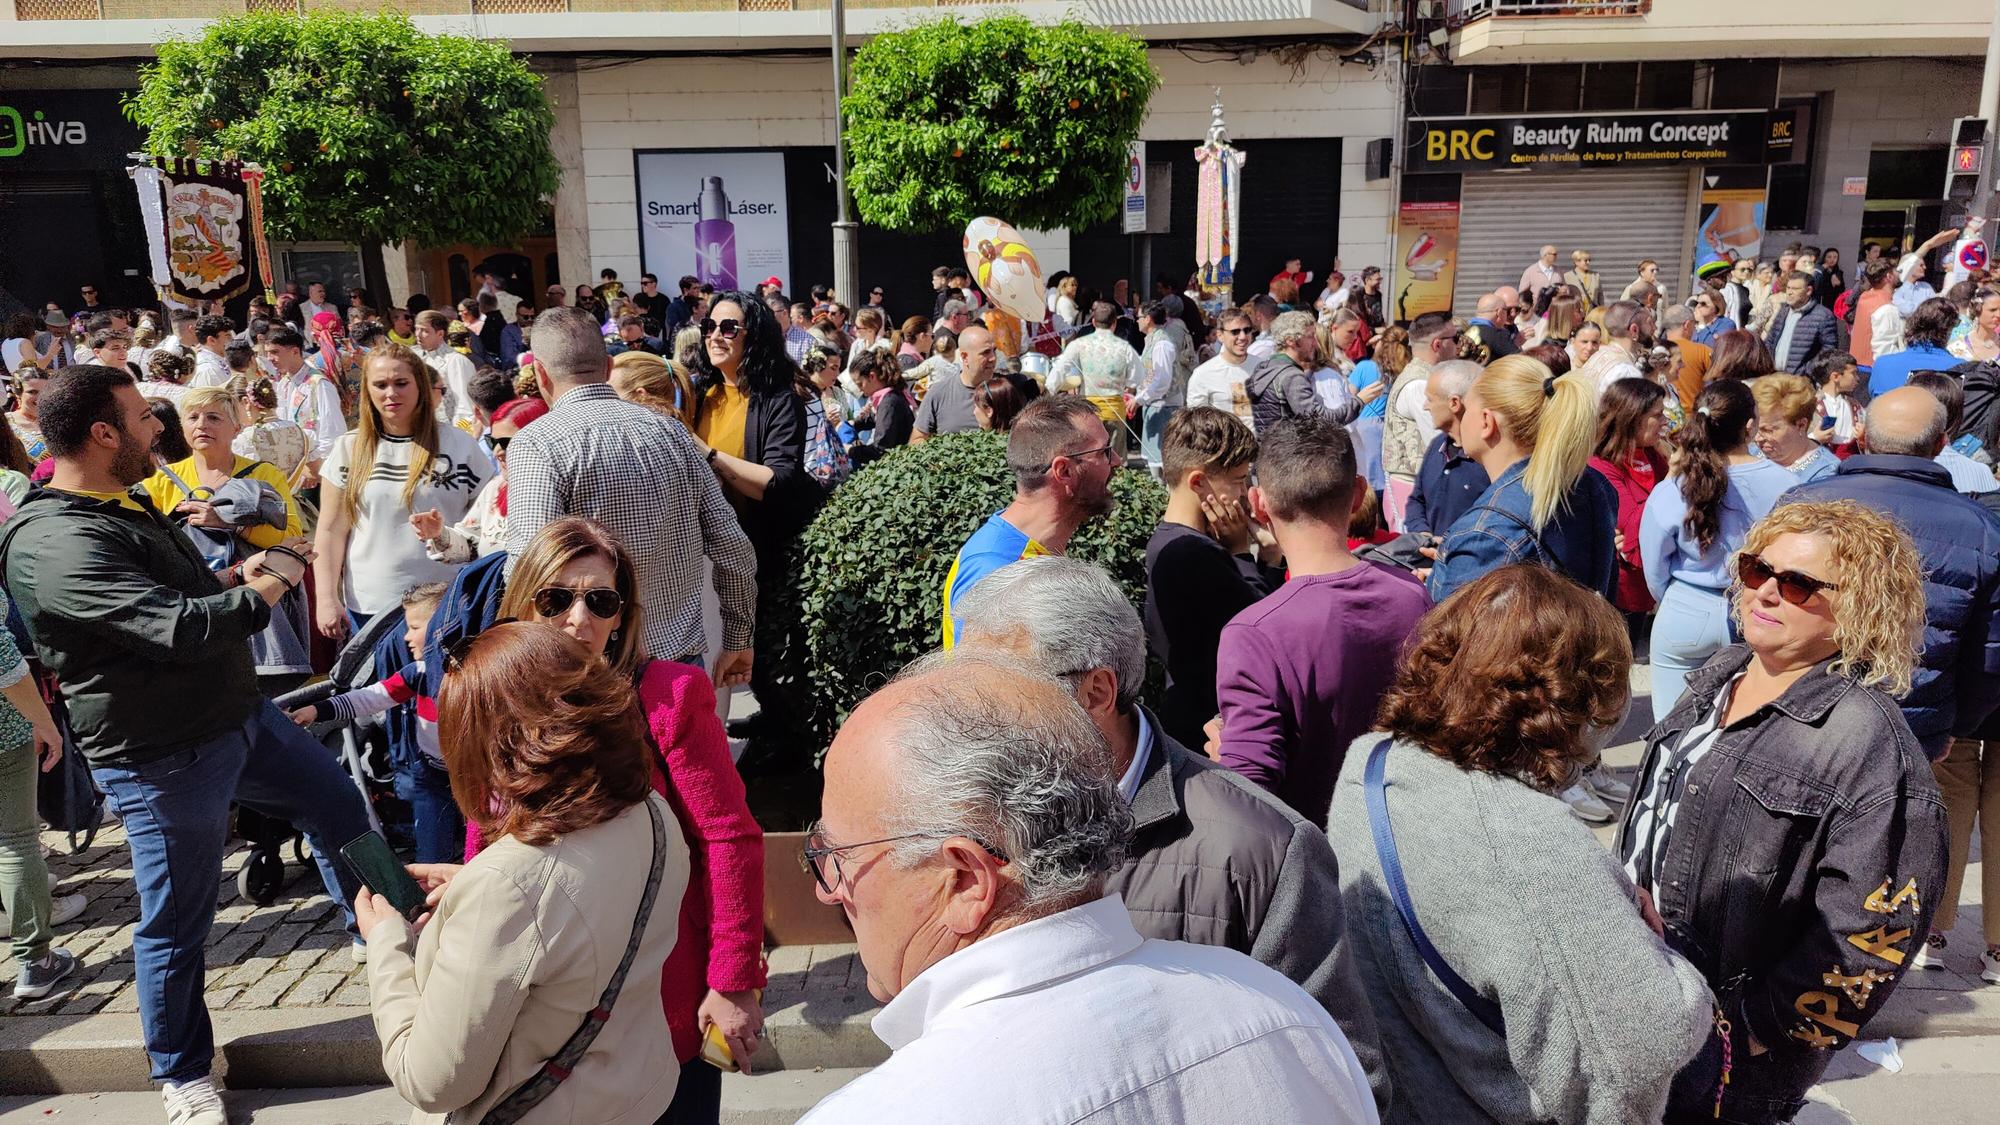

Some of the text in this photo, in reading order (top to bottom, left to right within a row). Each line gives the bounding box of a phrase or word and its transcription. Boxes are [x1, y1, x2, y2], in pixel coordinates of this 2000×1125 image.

[1512, 121, 1729, 150] Beauty Ruhm Concept
[1772, 121, 1791, 137] BRC
[1426, 129, 1495, 161] BRC
[1511, 149, 1728, 163] Centro de Pérdida de Peso y Tratamientos Corporales
[648, 200, 777, 215] Smart Láser.
